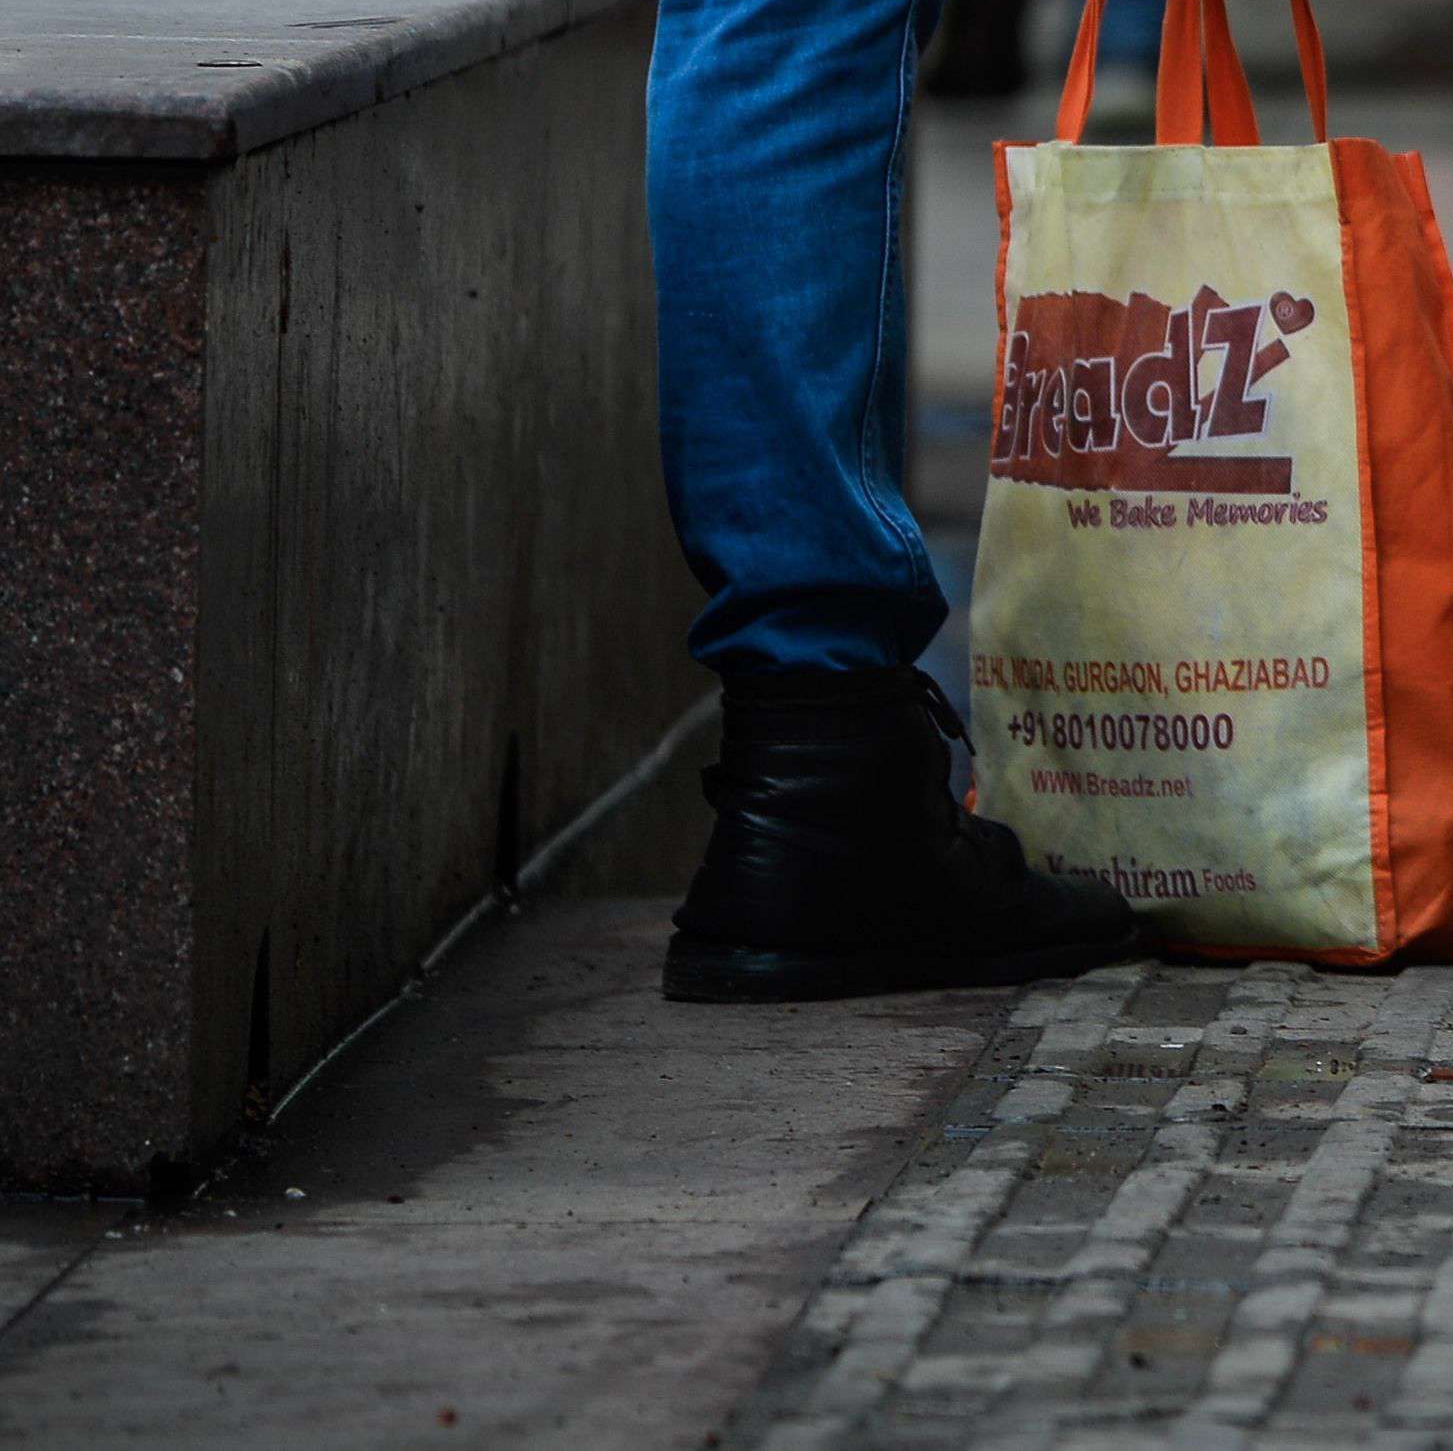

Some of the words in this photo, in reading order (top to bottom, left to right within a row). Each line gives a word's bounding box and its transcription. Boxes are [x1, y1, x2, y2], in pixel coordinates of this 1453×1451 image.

[1066, 498, 1102, 529] We
[1109, 495, 1177, 530] Bake
[1186, 492, 1329, 528] Memories
[974, 654, 1009, 690] ELHI,
[1063, 661, 1169, 699] GURGAON,
[1175, 656, 1330, 694] GHAZIABAD
[1202, 867, 1257, 893] Foods
